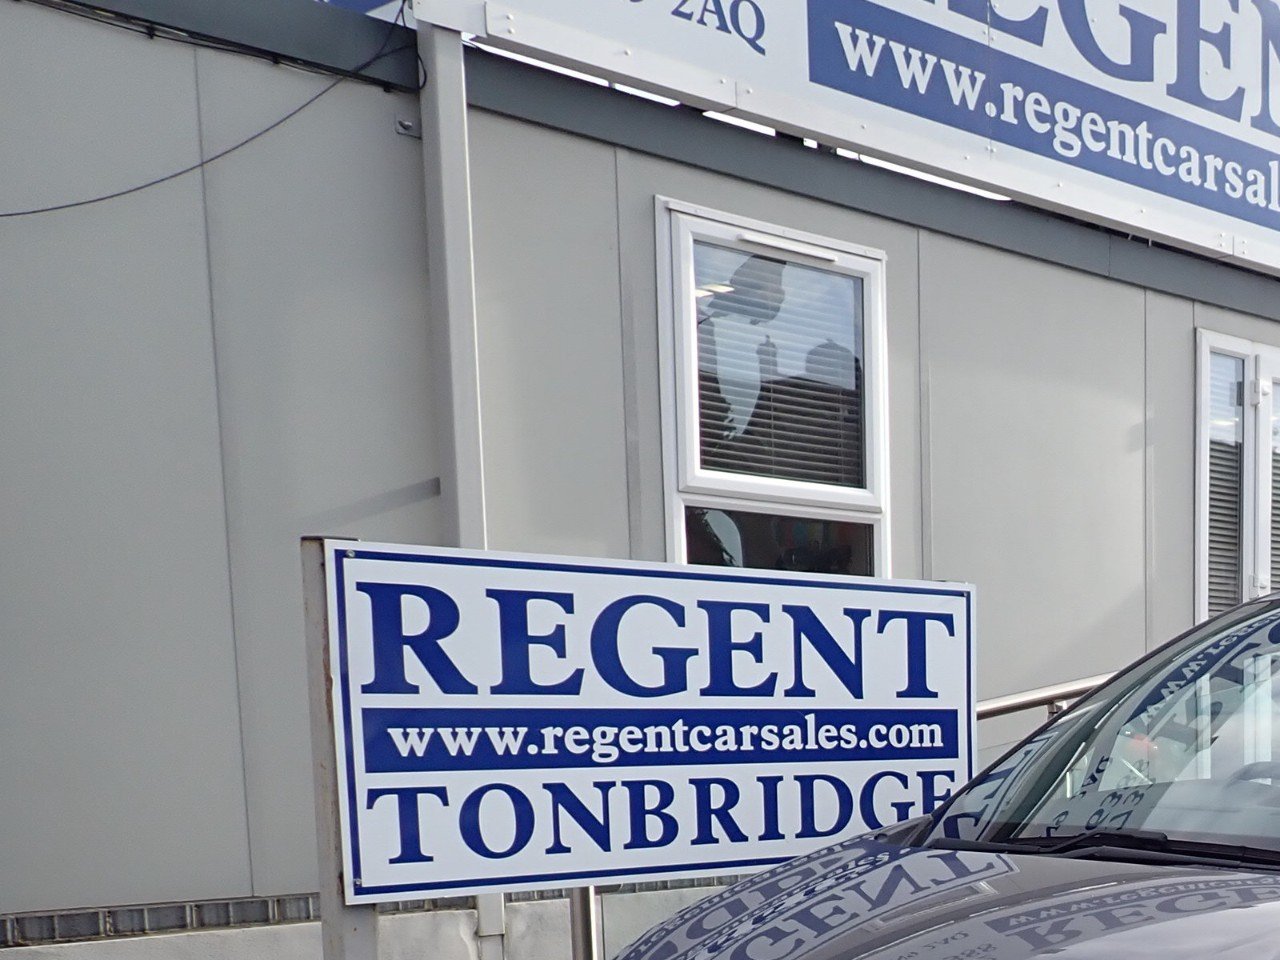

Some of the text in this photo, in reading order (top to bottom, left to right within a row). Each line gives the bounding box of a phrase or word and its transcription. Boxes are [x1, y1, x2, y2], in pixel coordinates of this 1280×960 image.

[356, 581, 955, 700] REGENT
[387, 712, 944, 763] www.regentcarsales.com
[366, 770, 956, 865] TONBRIDGE
